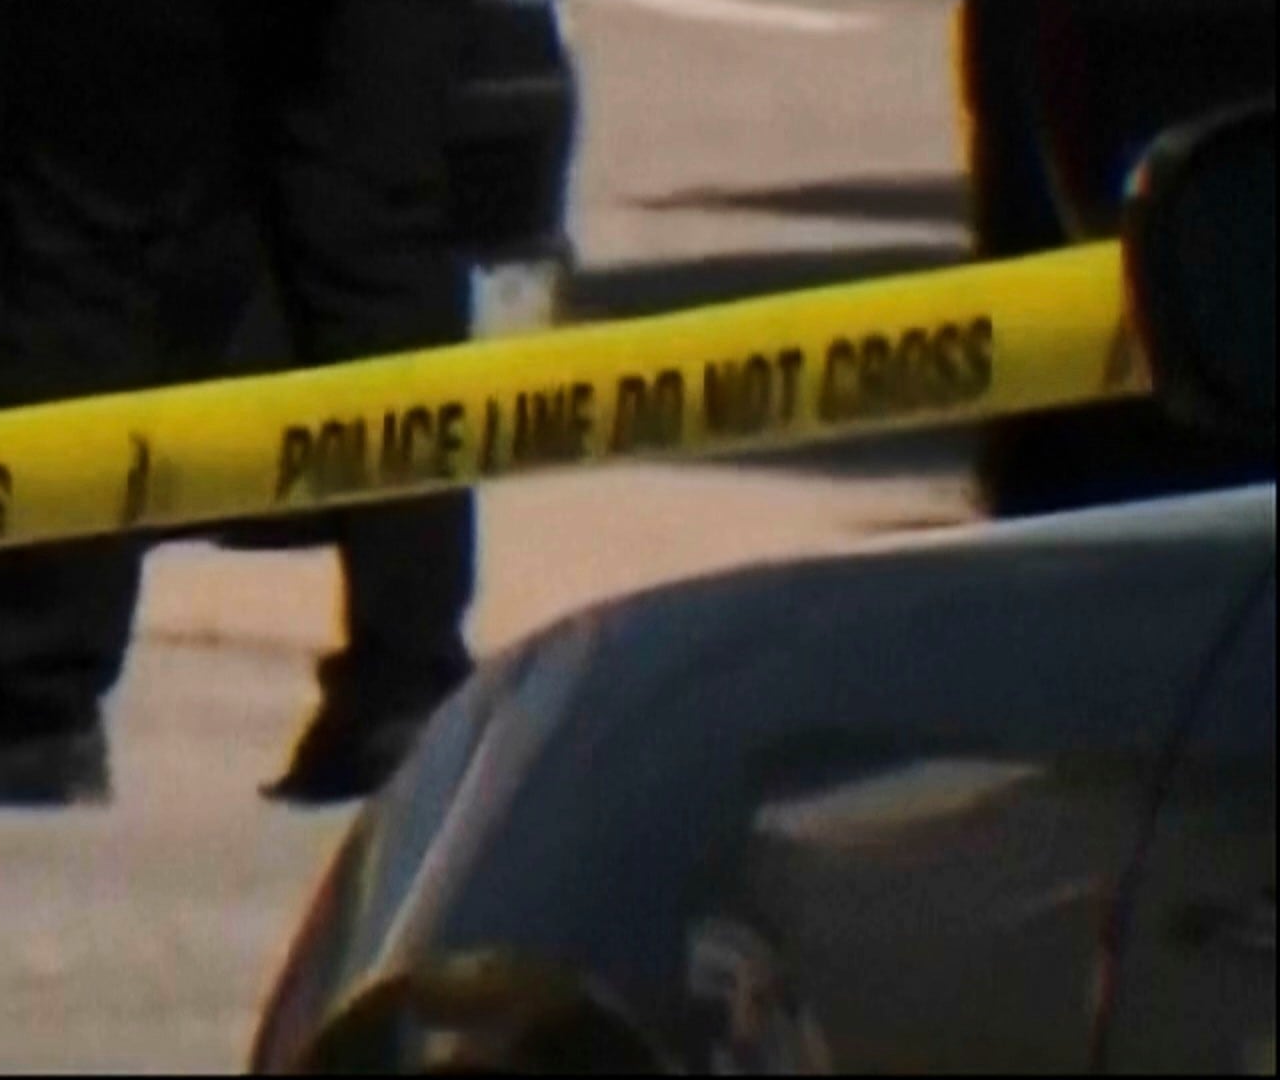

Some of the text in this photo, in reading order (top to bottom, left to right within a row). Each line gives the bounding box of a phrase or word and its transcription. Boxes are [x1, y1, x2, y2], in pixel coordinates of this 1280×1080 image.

[276, 316, 994, 500] POLICE LINE DO NOT CROSS
